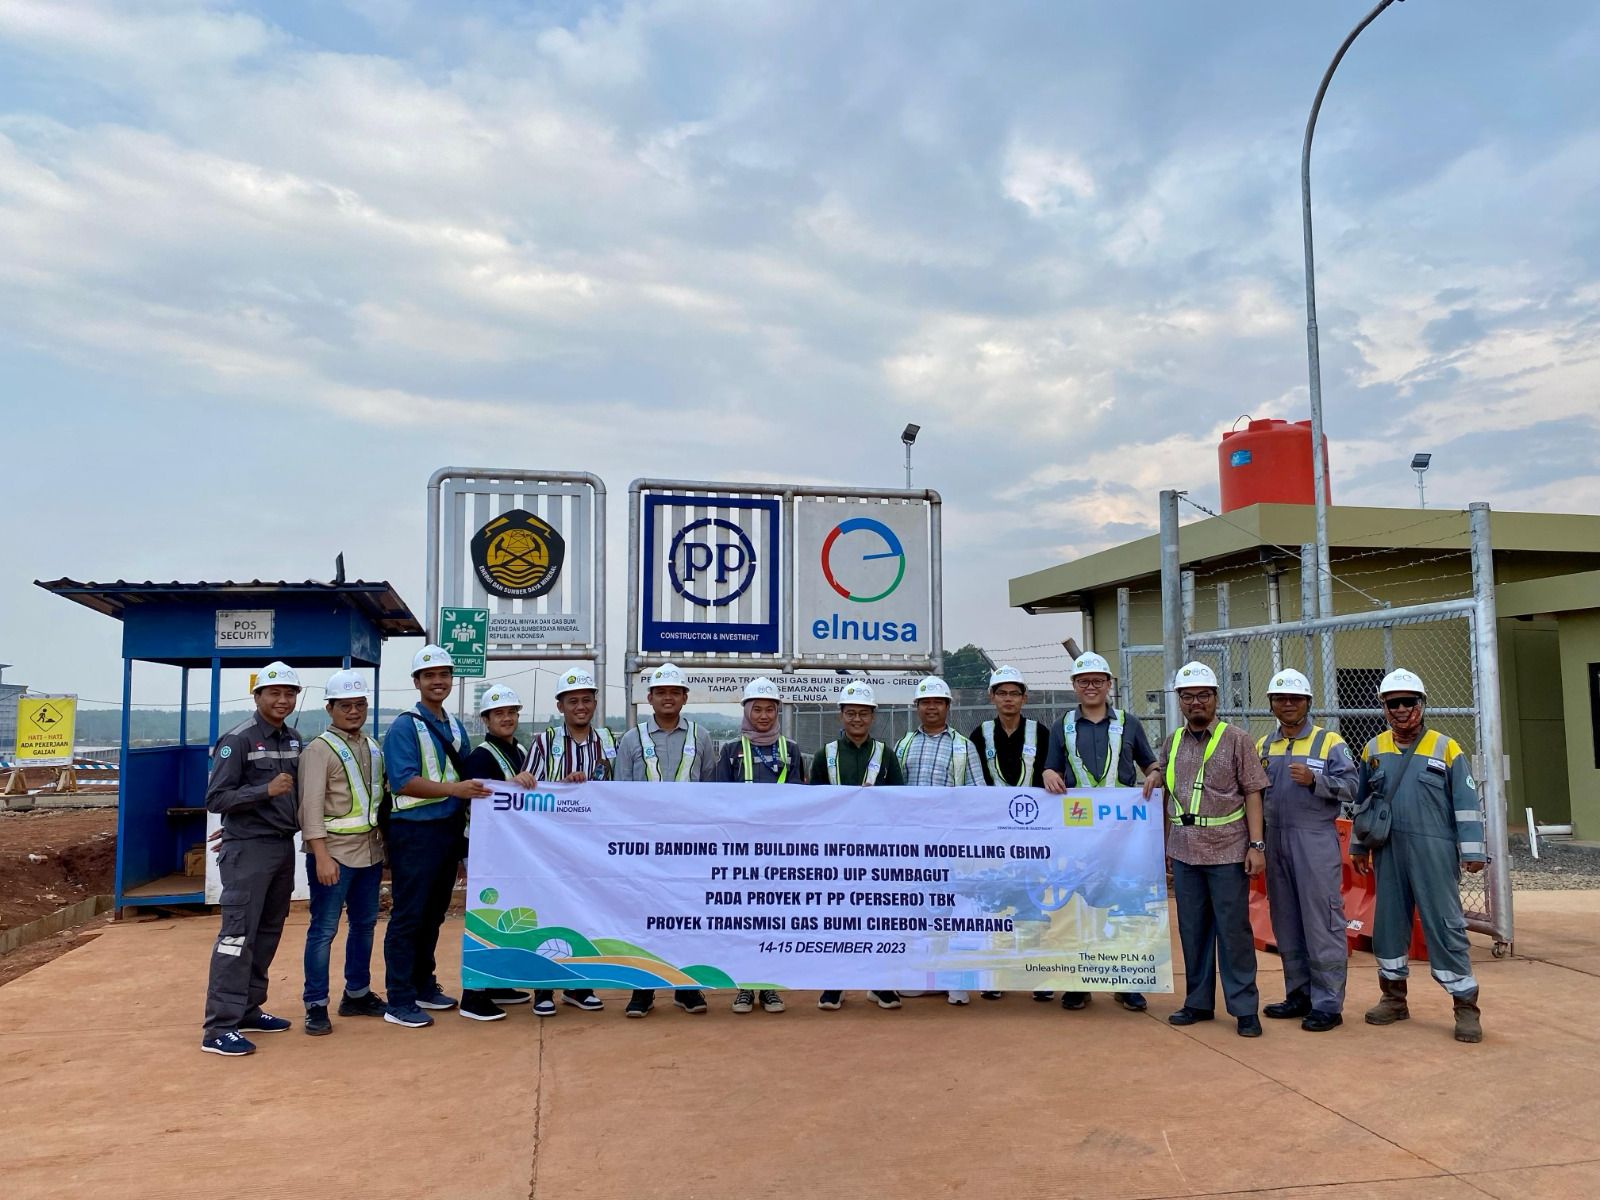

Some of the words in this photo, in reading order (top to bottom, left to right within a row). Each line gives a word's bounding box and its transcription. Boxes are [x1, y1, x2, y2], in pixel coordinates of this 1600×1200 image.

[479, 565, 494, 584] ENERGI
[492, 582, 503, 591] DAN
[527, 584, 542, 592] DAYA
[540, 566, 557, 586] MINERAL
[234, 620, 257, 630] POS
[812, 613, 917, 642] elnusa
[220, 631, 269, 640] SECURITY
[660, 631, 712, 640] CONSTRUCTION
[713, 632, 718, 640] &
[719, 633, 759, 641] INVESTMENT
[1098, 805, 1147, 820] PLN
[607, 841, 650, 856] STUDI
[654, 842, 718, 856] BANDING
[722, 842, 749, 856] TIM
[754, 843, 819, 857] BUILDING
[823, 843, 920, 858] INFORMATION
[924, 844, 1006, 859] MODELLING
[1009, 845, 1051, 860] (BIM)
[711, 866, 729, 880] PT
[733, 866, 760, 880] PLN
[764, 866, 839, 881] (PERSERO)
[843, 867, 867, 881] UIP
[871, 868, 950, 882] SUMBAGUT
[705, 891, 742, 905] PADA
[747, 891, 801, 905] PROYEK
[805, 892, 823, 905] PT
[827, 892, 845, 906] PP
[850, 892, 925, 907] (PERSERO)
[928, 893, 956, 907] TBK
[646, 916, 702, 930] PROYEK
[706, 916, 786, 930] TRANSMISI
[790, 917, 819, 930] GAS
[823, 917, 862, 931] BUMI
[866, 917, 1014, 932] CIREBON-SEMARANG
[758, 942, 793, 953] 14-15
[795, 942, 873, 953] DESEMBER
[876, 942, 906, 954] 2023
[1079, 952, 1095, 961] The
[1098, 953, 1119, 961] New
[1121, 953, 1139, 961] PLN
[1141, 954, 1155, 962] 4.0
[1025, 963, 1076, 973] Unleashing
[1077, 965, 1110, 974] Energy
[1112, 965, 1119, 973] &
[1121, 965, 1156, 975] Beyond
[1081, 975, 1157, 986] www.pln.co.id
